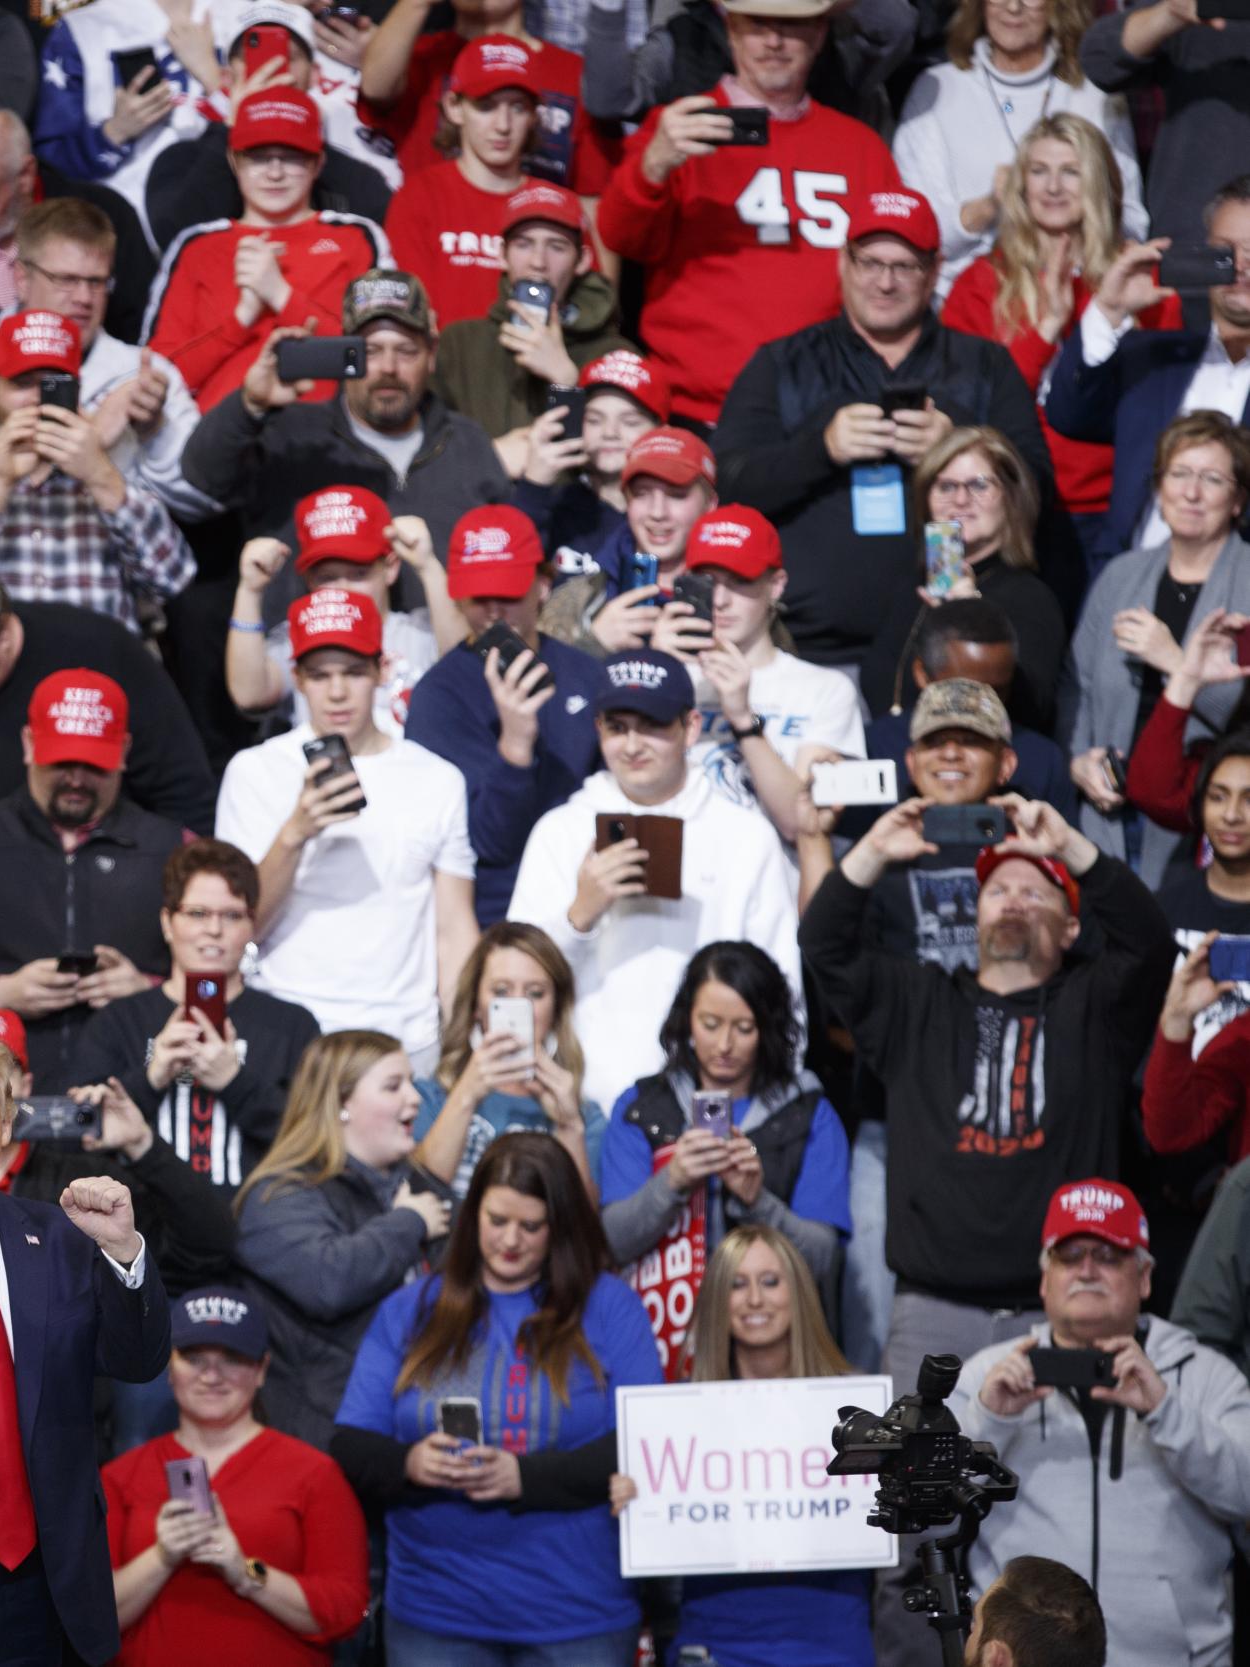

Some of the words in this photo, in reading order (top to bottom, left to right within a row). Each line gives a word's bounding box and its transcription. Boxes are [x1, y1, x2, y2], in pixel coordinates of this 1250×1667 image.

[735, 166, 850, 249] 45
[303, 504, 368, 528] AMERICA
[297, 603, 363, 625] AMERICA
[47, 702, 114, 721] AMERICA
[1060, 1185, 1125, 1212] TRUMP
[668, 1502, 731, 1524] FOR
[743, 1497, 851, 1521] TRUMP
